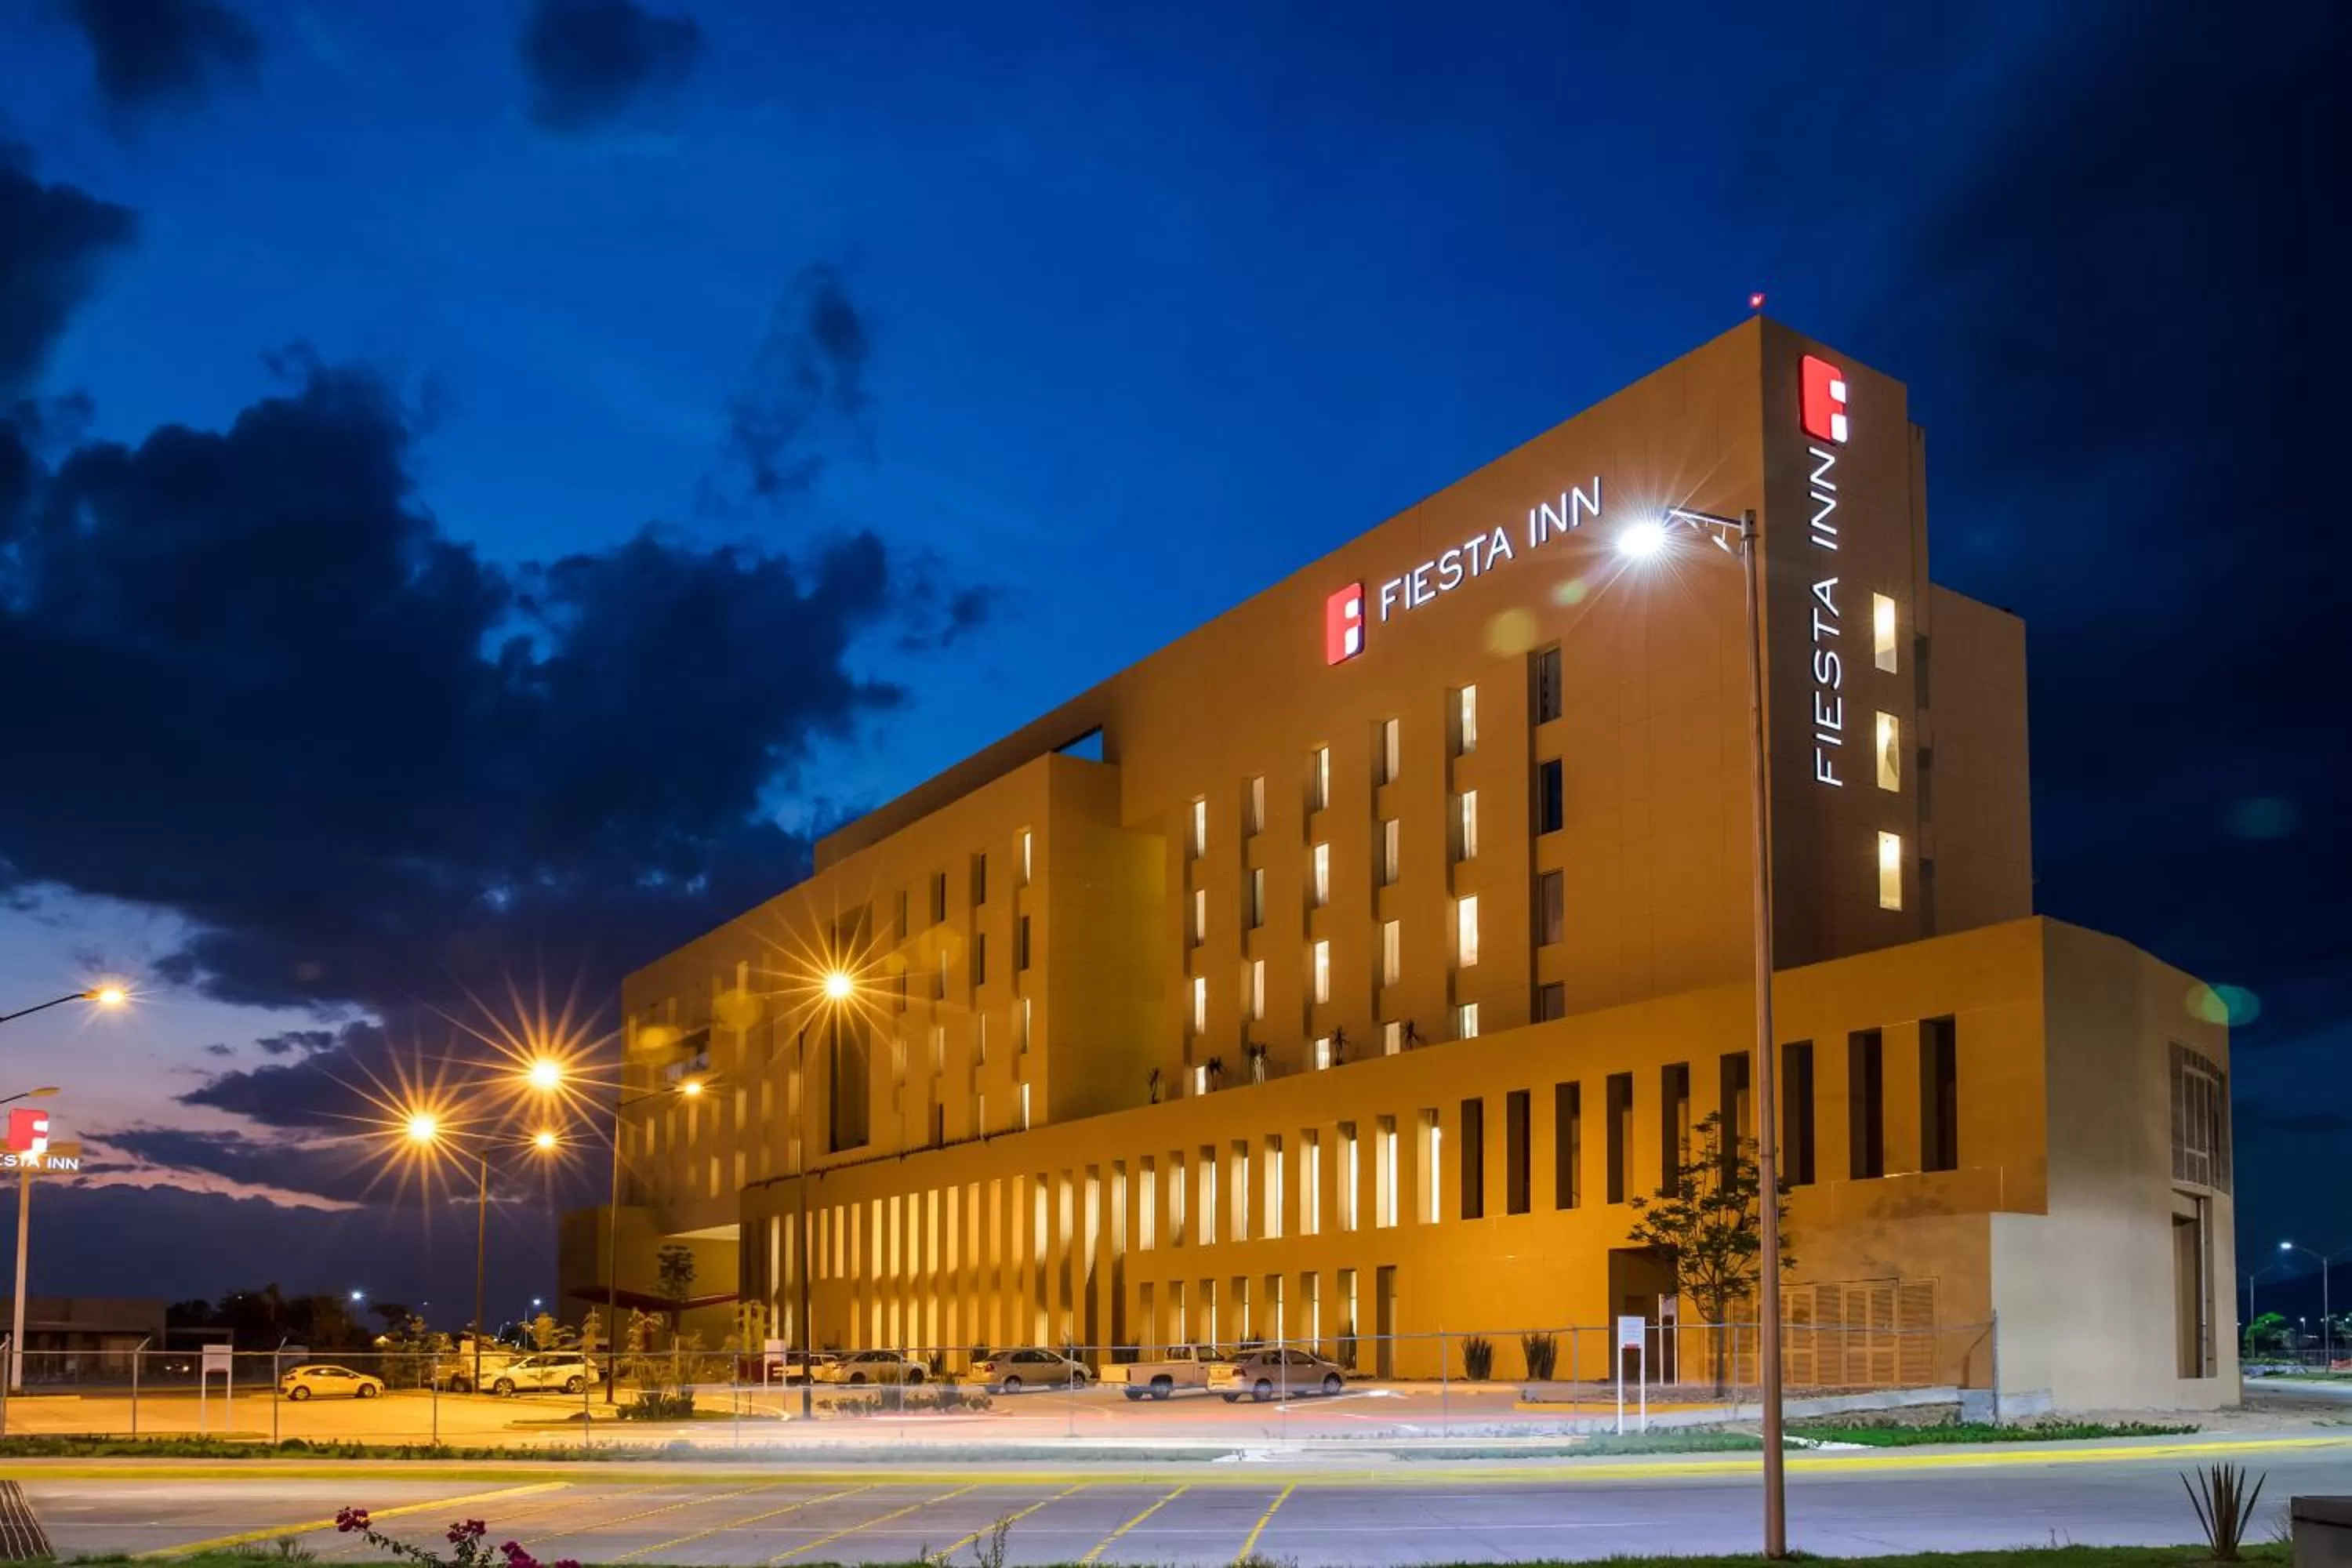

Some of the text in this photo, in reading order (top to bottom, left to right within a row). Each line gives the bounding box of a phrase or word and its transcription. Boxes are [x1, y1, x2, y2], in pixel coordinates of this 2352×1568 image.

[1380, 476, 1601, 622] FIESTA INN
[1809, 446, 1843, 786] FIESTA INN
[47, 1156, 78, 1171] INN
